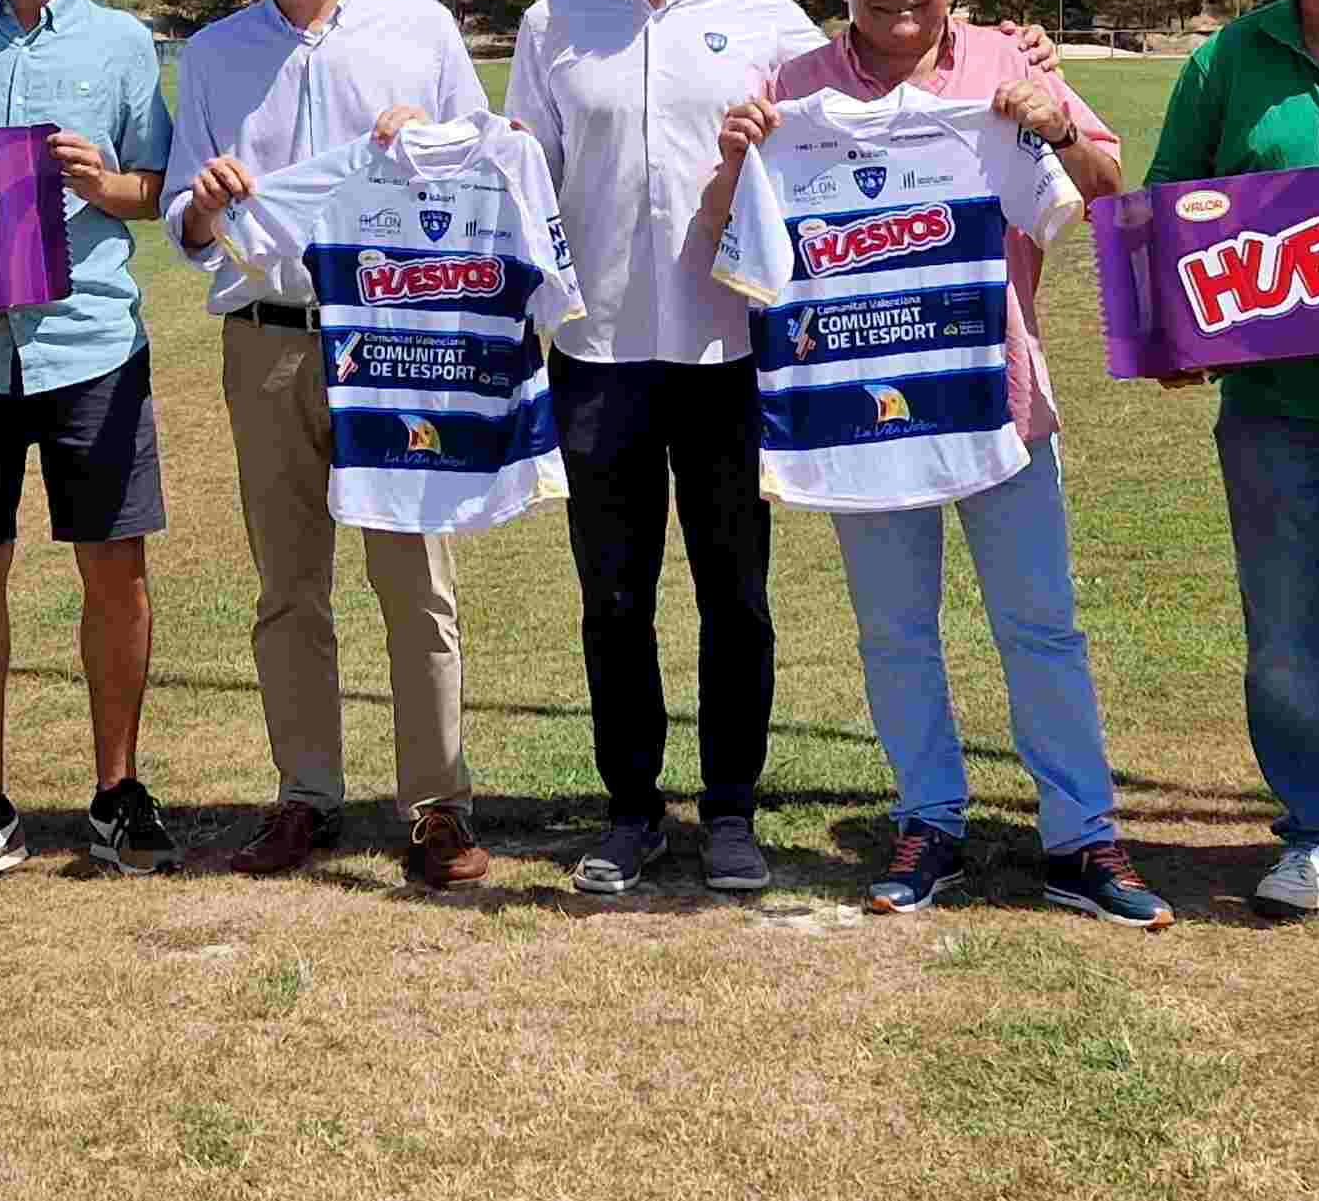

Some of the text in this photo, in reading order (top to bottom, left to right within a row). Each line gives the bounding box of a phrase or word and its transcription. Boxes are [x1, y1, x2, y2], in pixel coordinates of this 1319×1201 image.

[806, 208, 947, 273] HUESITOS
[362, 260, 499, 299] HUESITOS
[817, 306, 922, 334] COMUNITAT
[827, 332, 852, 350] DE
[854, 322, 937, 347] L'ESPORT
[362, 344, 466, 364] COMUNITAT
[370, 361, 394, 377] DE
[397, 362, 476, 380] L'ESPORT
